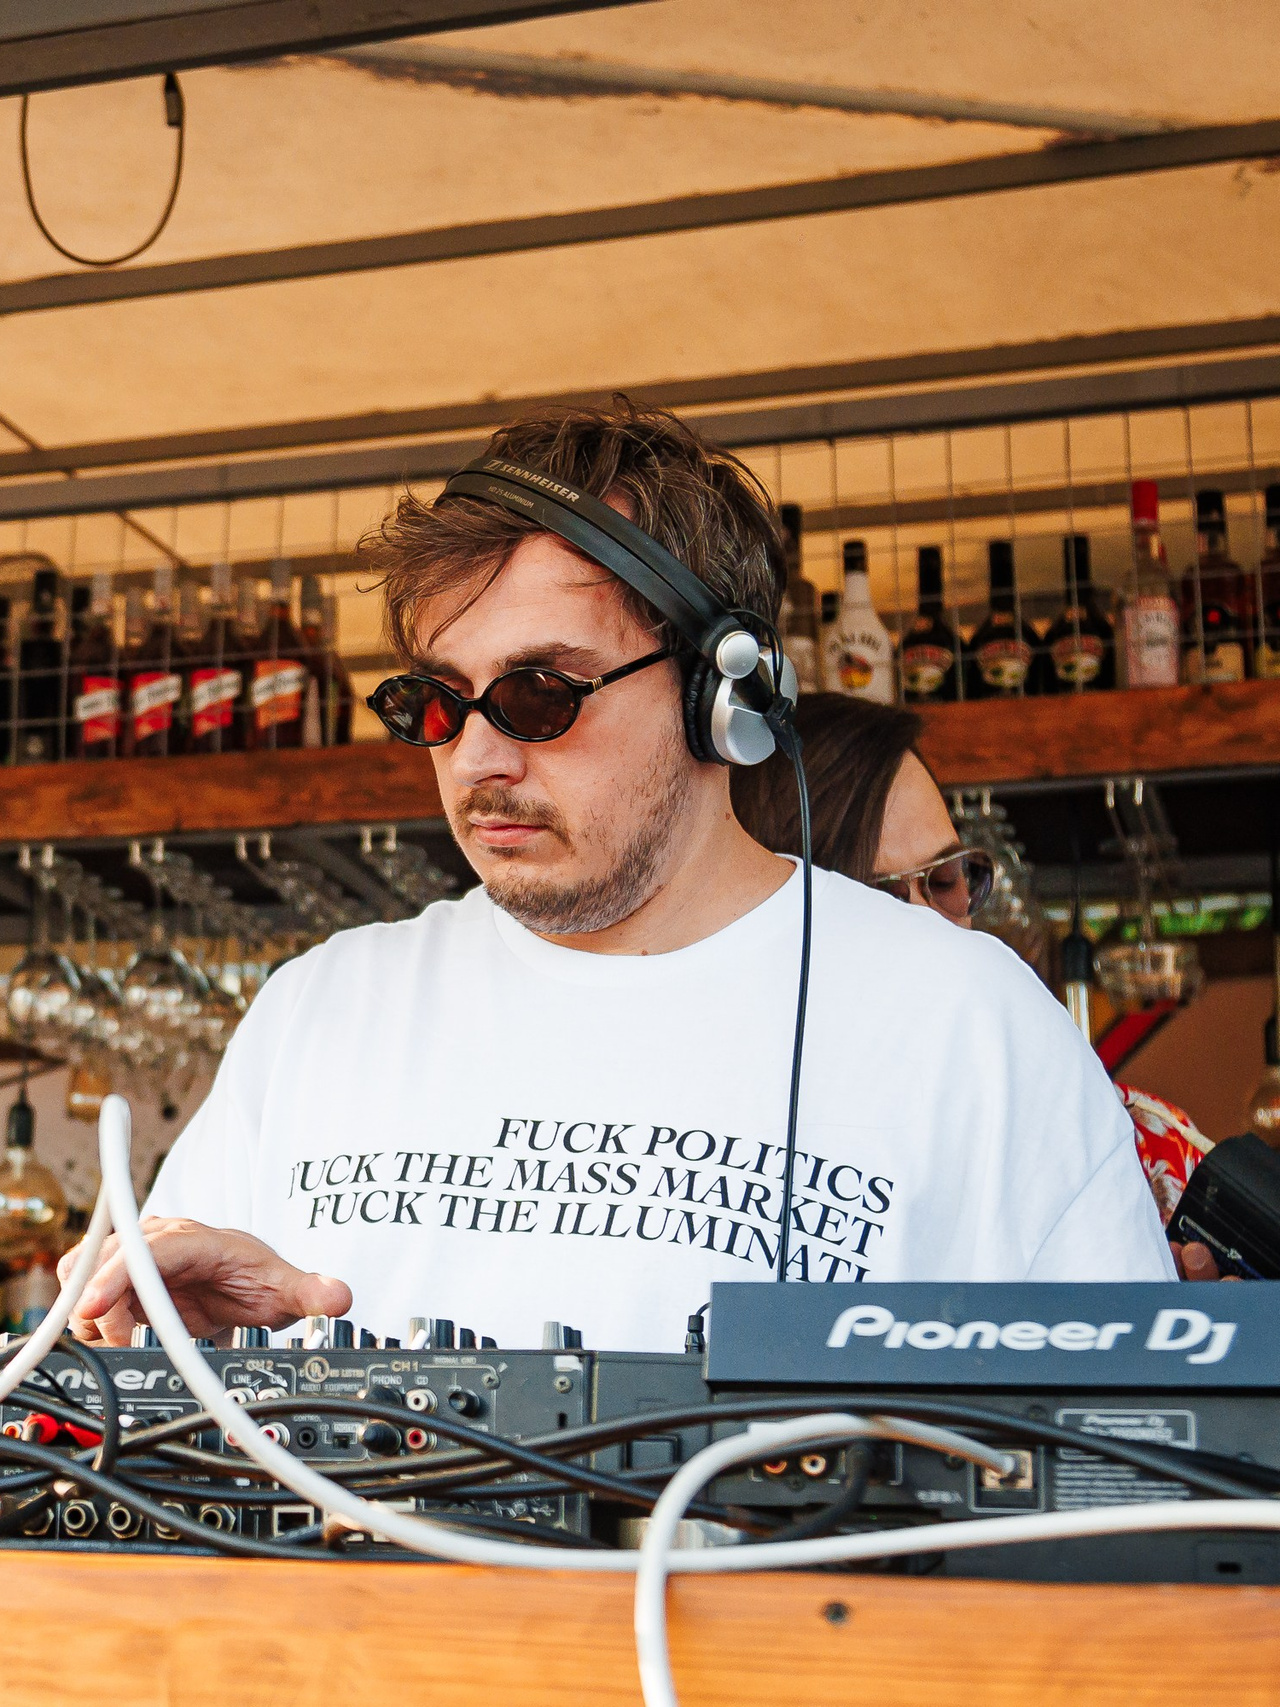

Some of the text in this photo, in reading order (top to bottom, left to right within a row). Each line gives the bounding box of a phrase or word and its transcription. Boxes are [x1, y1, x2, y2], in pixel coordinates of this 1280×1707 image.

[500, 464, 580, 503] SENNHEISER
[492, 1117, 894, 1214] FUCK POLITICS
[307, 1190, 427, 1230] FUCK
[438, 1193, 539, 1233] THE
[393, 1151, 494, 1188] THE
[503, 1158, 641, 1195] MASS
[648, 1165, 884, 1258] MARKET
[826, 1304, 1134, 1351] Pioneer
[231, 1374, 252, 1384] LINE
[371, 1375, 403, 1385] PHONO
[415, 1375, 429, 1386] CD
